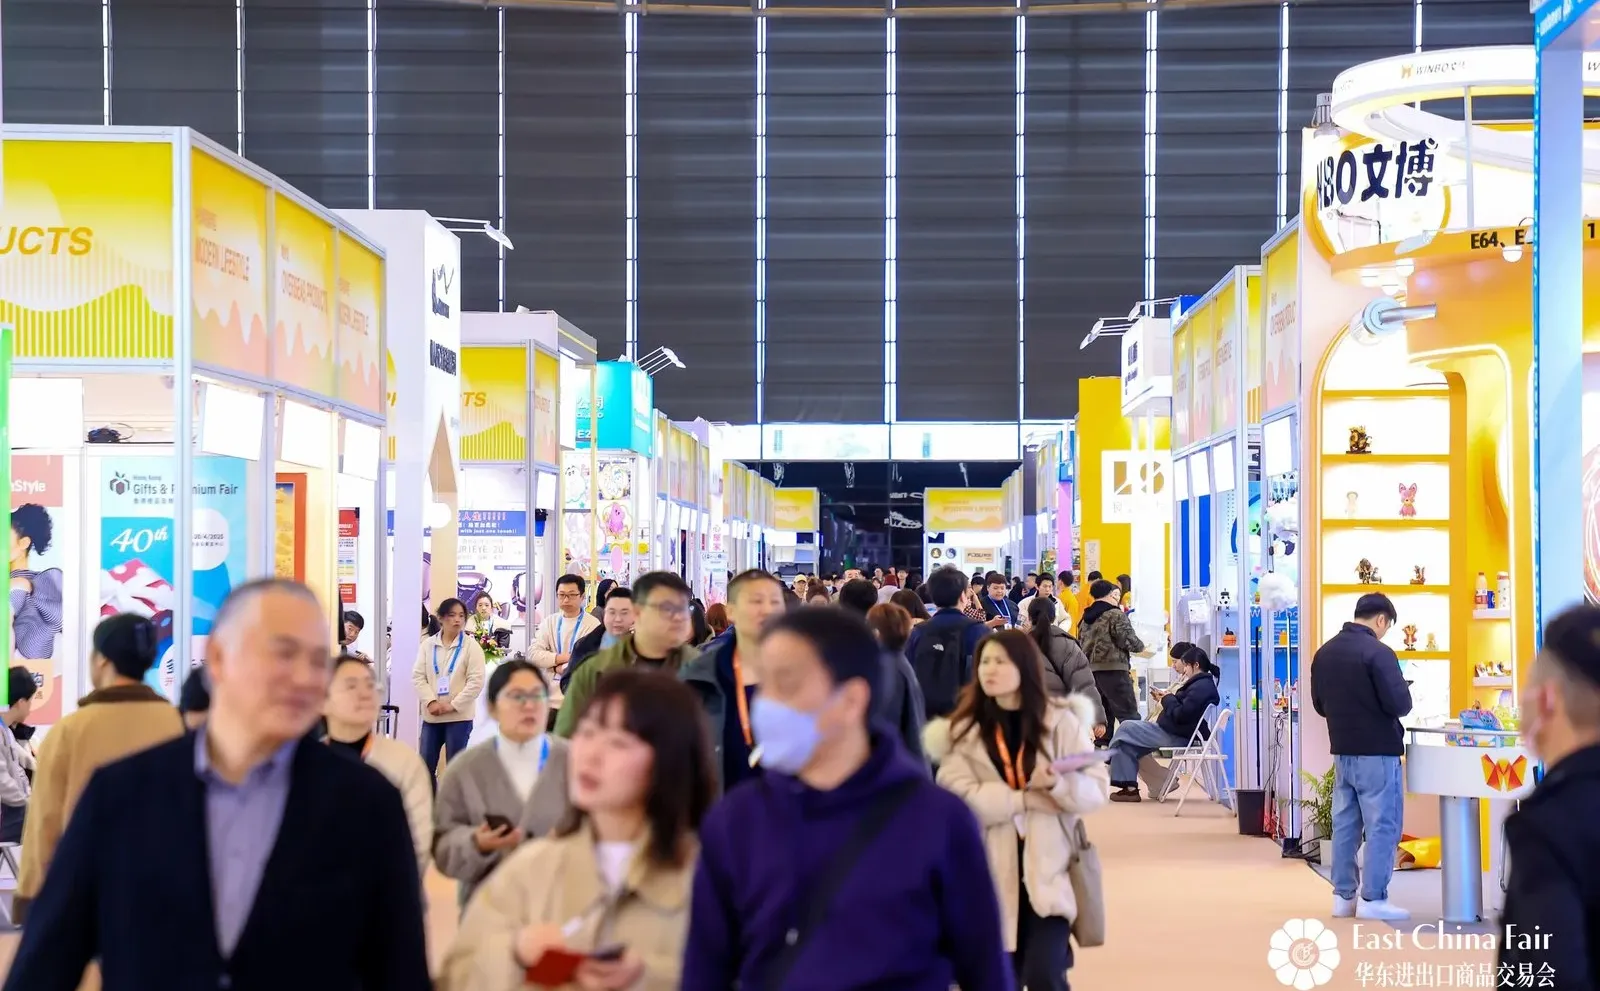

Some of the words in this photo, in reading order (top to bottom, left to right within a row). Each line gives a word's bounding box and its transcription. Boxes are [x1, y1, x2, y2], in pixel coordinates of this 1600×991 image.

[133, 484, 156, 495] Gifts
[160, 484, 168, 495] &
[219, 484, 238, 495] Fair
